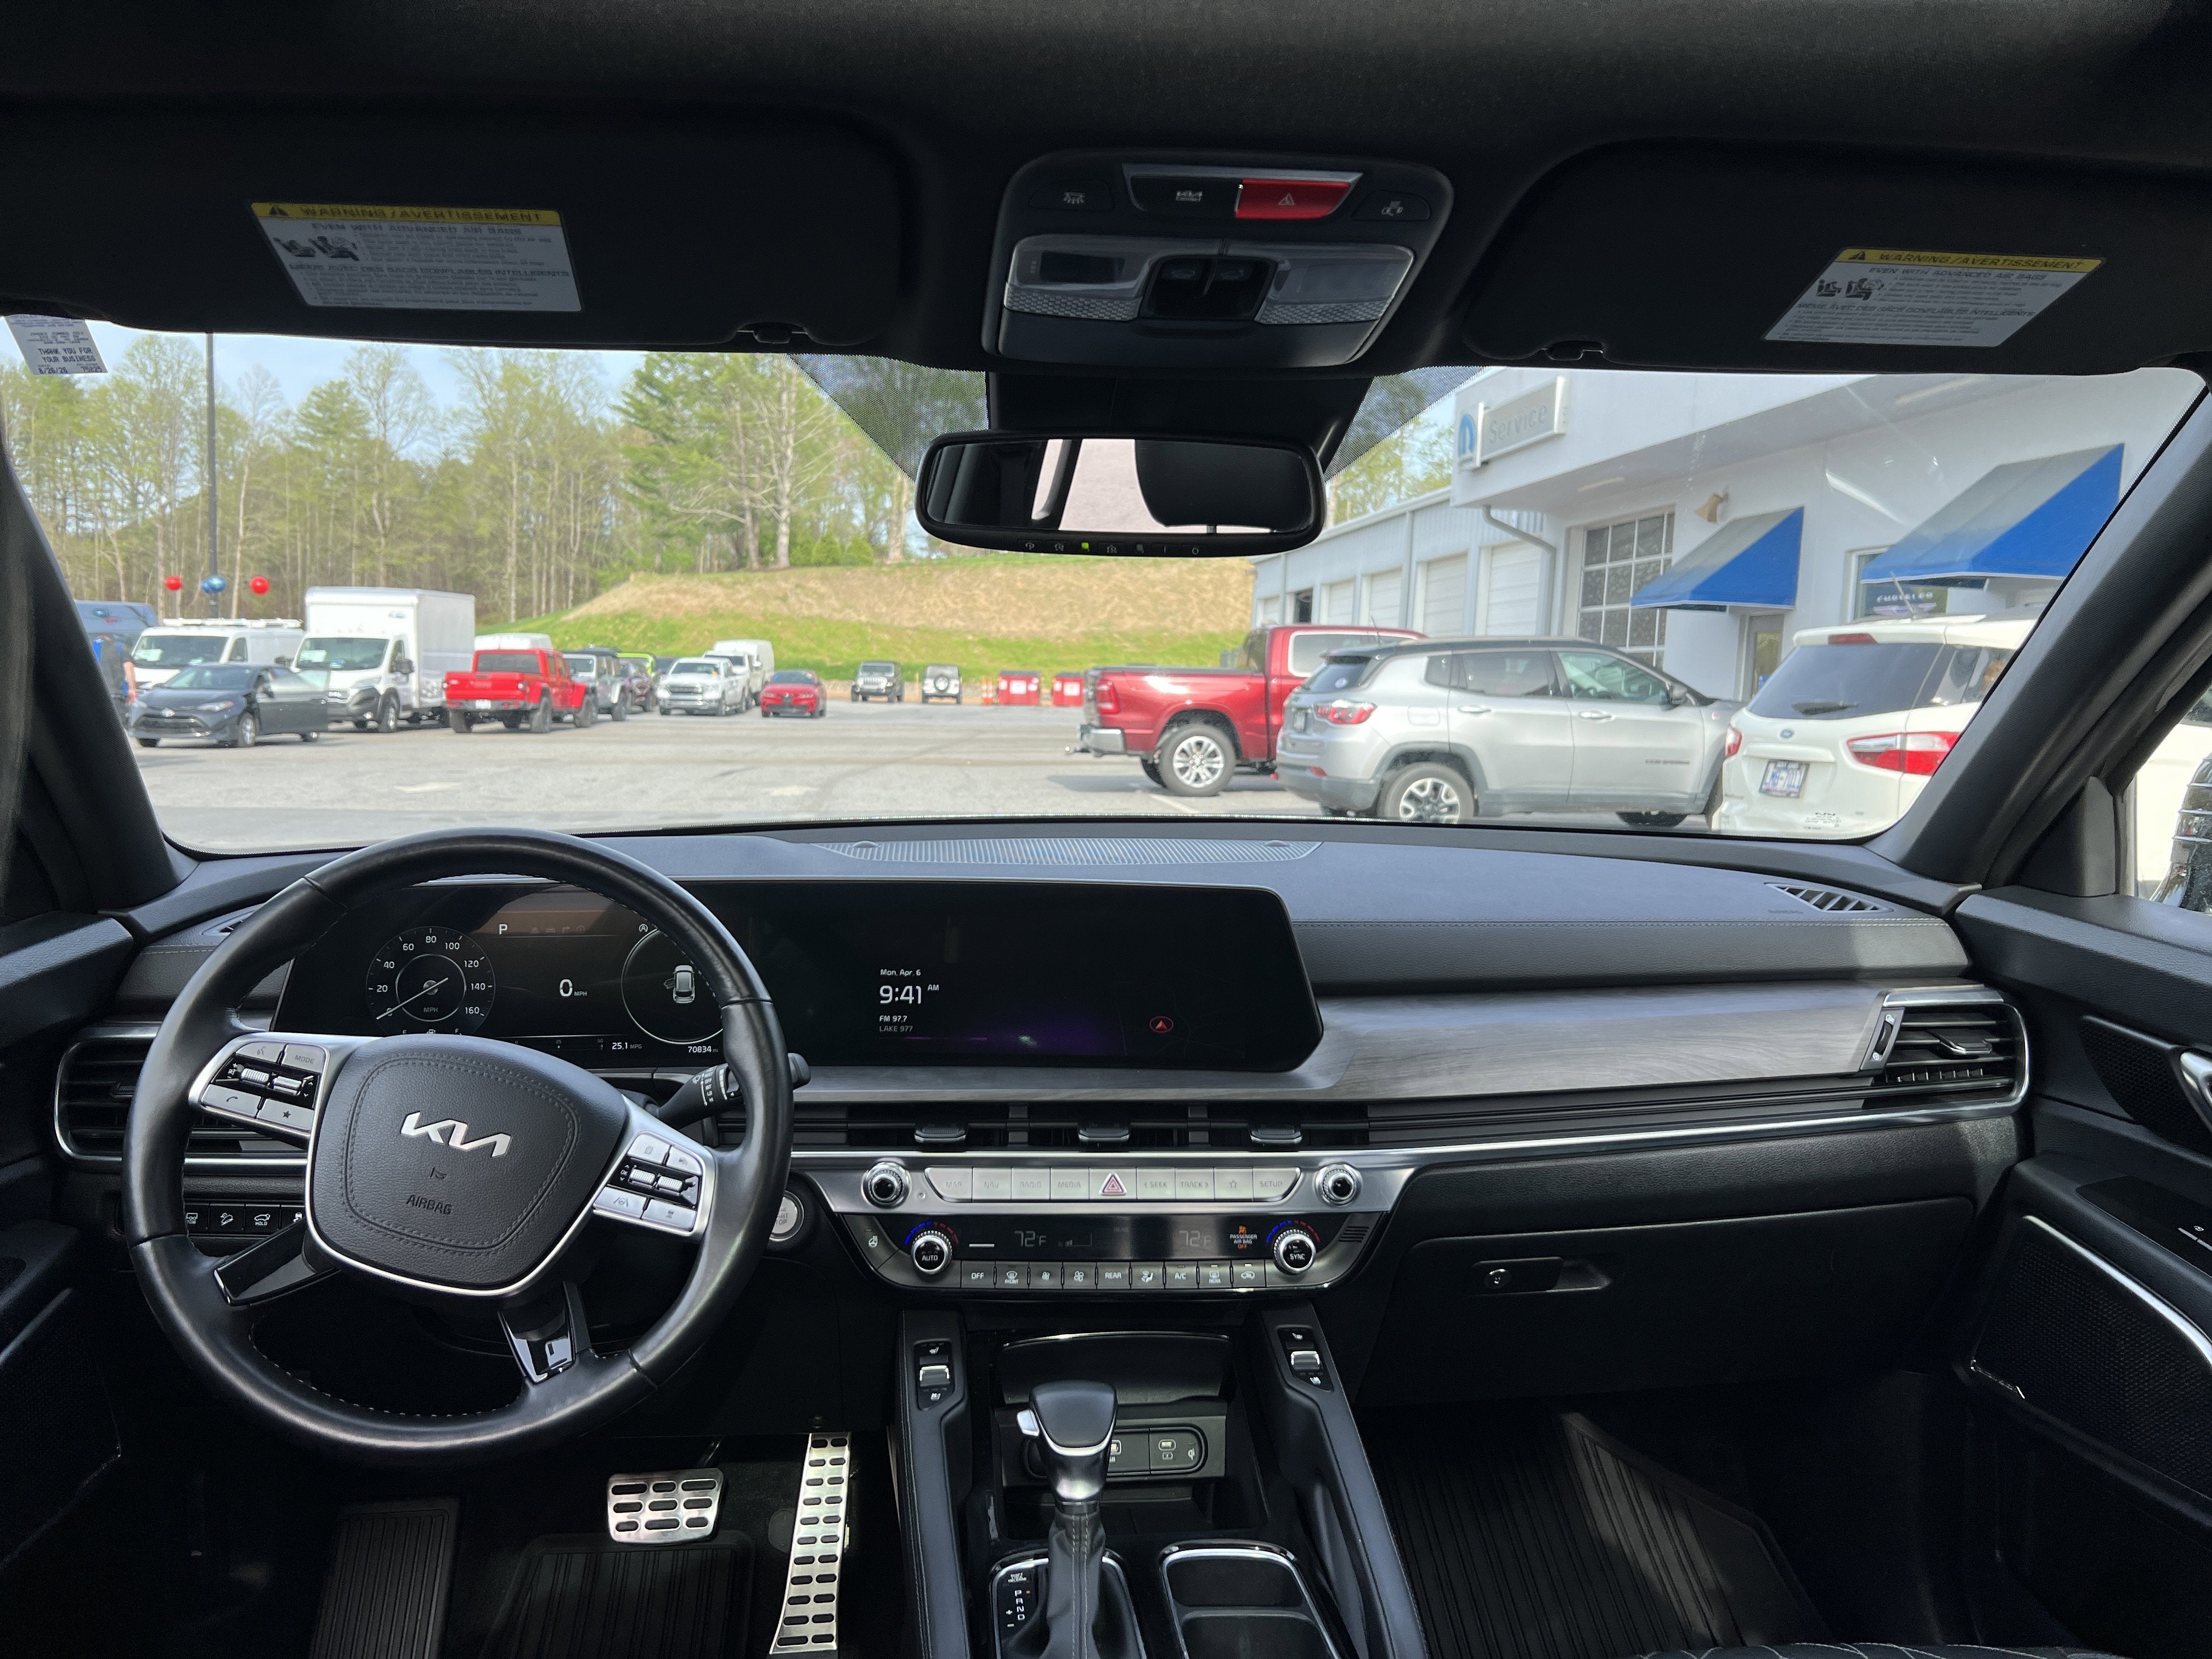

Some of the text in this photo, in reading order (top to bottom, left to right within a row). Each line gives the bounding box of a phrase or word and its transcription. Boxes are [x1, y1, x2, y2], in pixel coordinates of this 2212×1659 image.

[1489, 404, 1548, 442] Service
[498, 924, 508, 934] P
[425, 935, 437, 944] 80
[402, 943, 414, 951] 60
[444, 941, 461, 950] 100
[383, 961, 395, 969] 40
[464, 960, 480, 968] 120
[900, 968, 915, 977] Apr.
[376, 984, 388, 993] 20
[471, 982, 487, 991] 140
[559, 979, 573, 997] 0
[879, 985, 922, 1005] 9:41
[465, 1006, 480, 1014] 160
[612, 1042, 628, 1051] 25.1
[687, 1045, 712, 1054] 70834
[295, 1055, 315, 1064] MODE
[406, 1194, 453, 1215] AIRBAG
